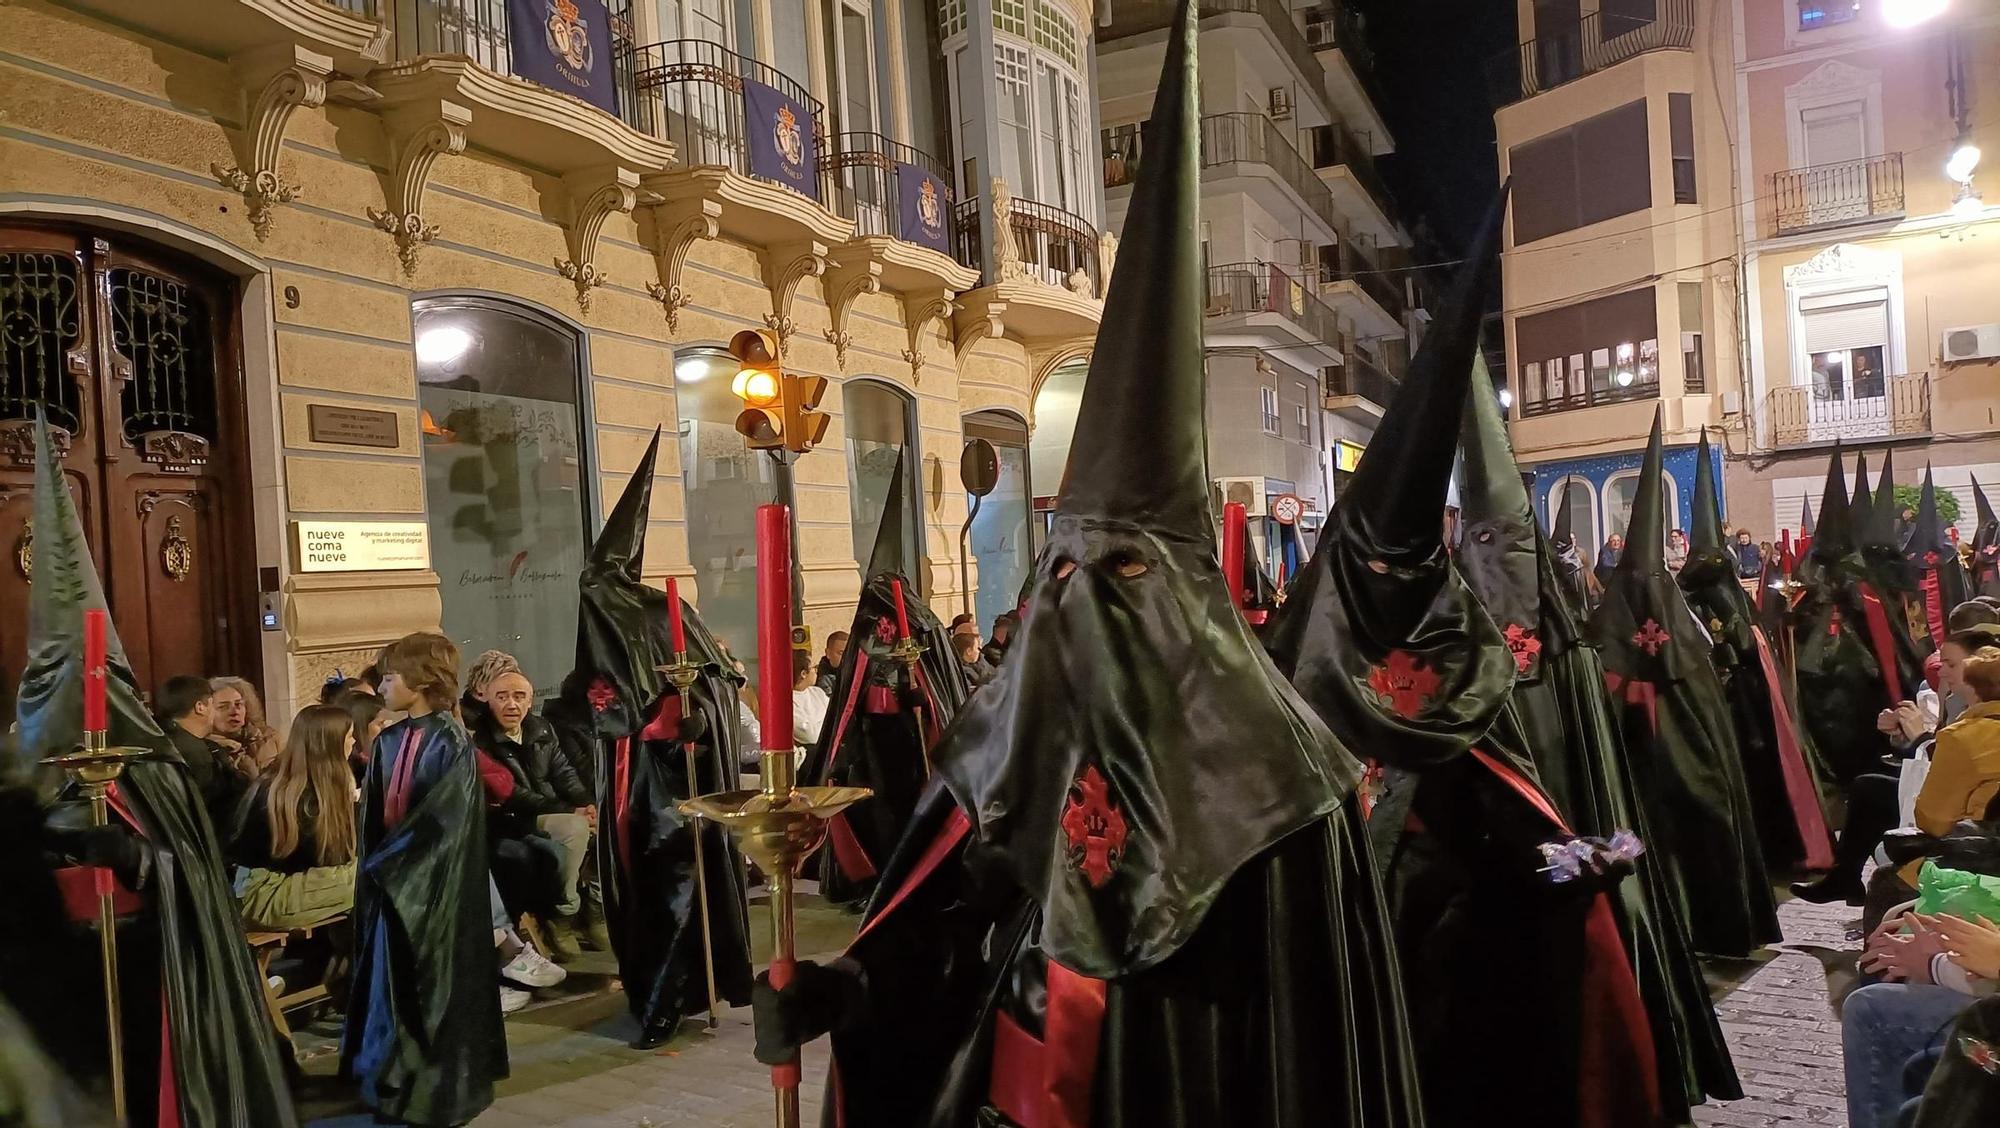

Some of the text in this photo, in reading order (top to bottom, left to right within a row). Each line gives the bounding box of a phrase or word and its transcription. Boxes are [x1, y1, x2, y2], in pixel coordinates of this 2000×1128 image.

[284, 285, 300, 309] 9
[307, 531, 345, 540] nueve
[308, 541, 342, 551] coma
[309, 553, 346, 562] nueve
